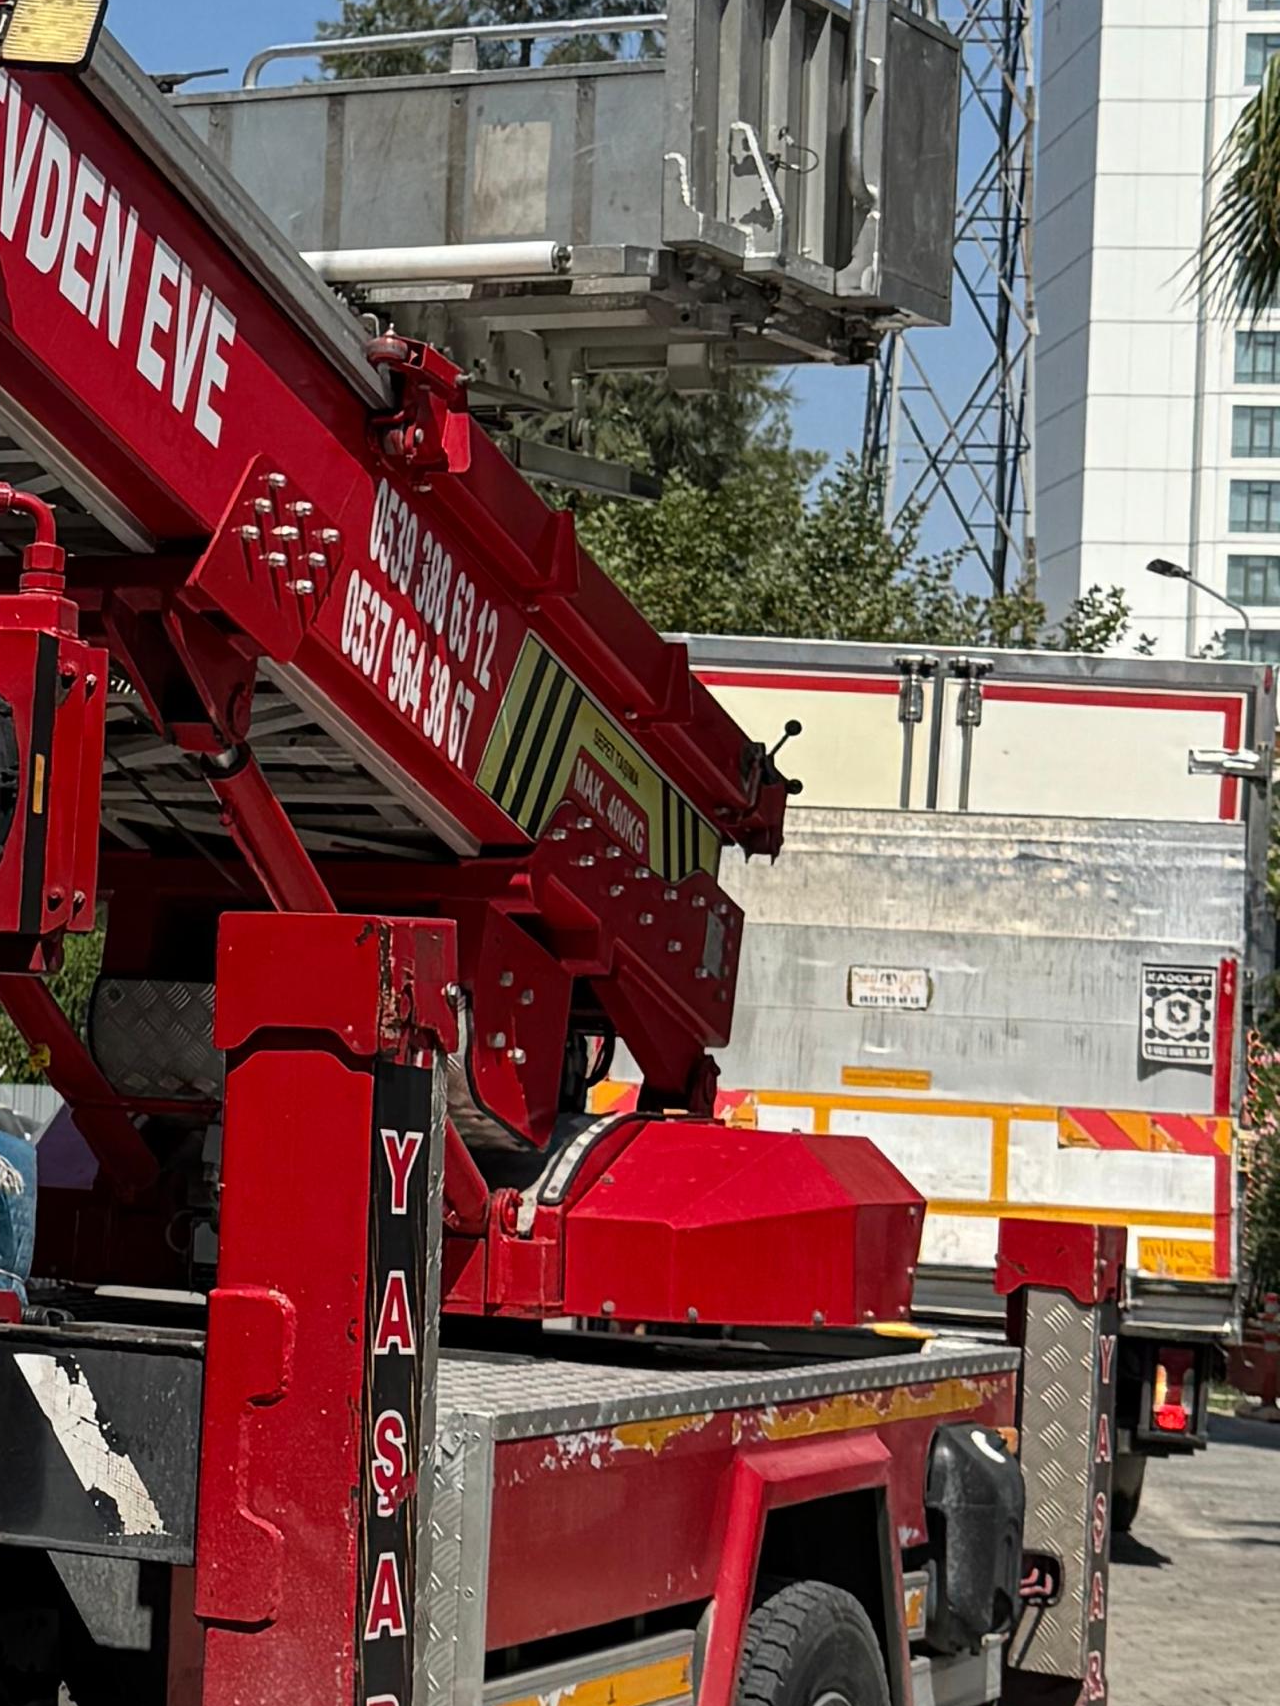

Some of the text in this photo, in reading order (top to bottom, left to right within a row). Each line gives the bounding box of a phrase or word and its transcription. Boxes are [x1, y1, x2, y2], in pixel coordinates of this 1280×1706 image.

[137, 235, 237, 449] EVE
[342, 569, 475, 770] 0537 964 38 67
[370, 477, 418, 595] 0539
[448, 571, 475, 663] 63
[473, 599, 498, 691] 12
